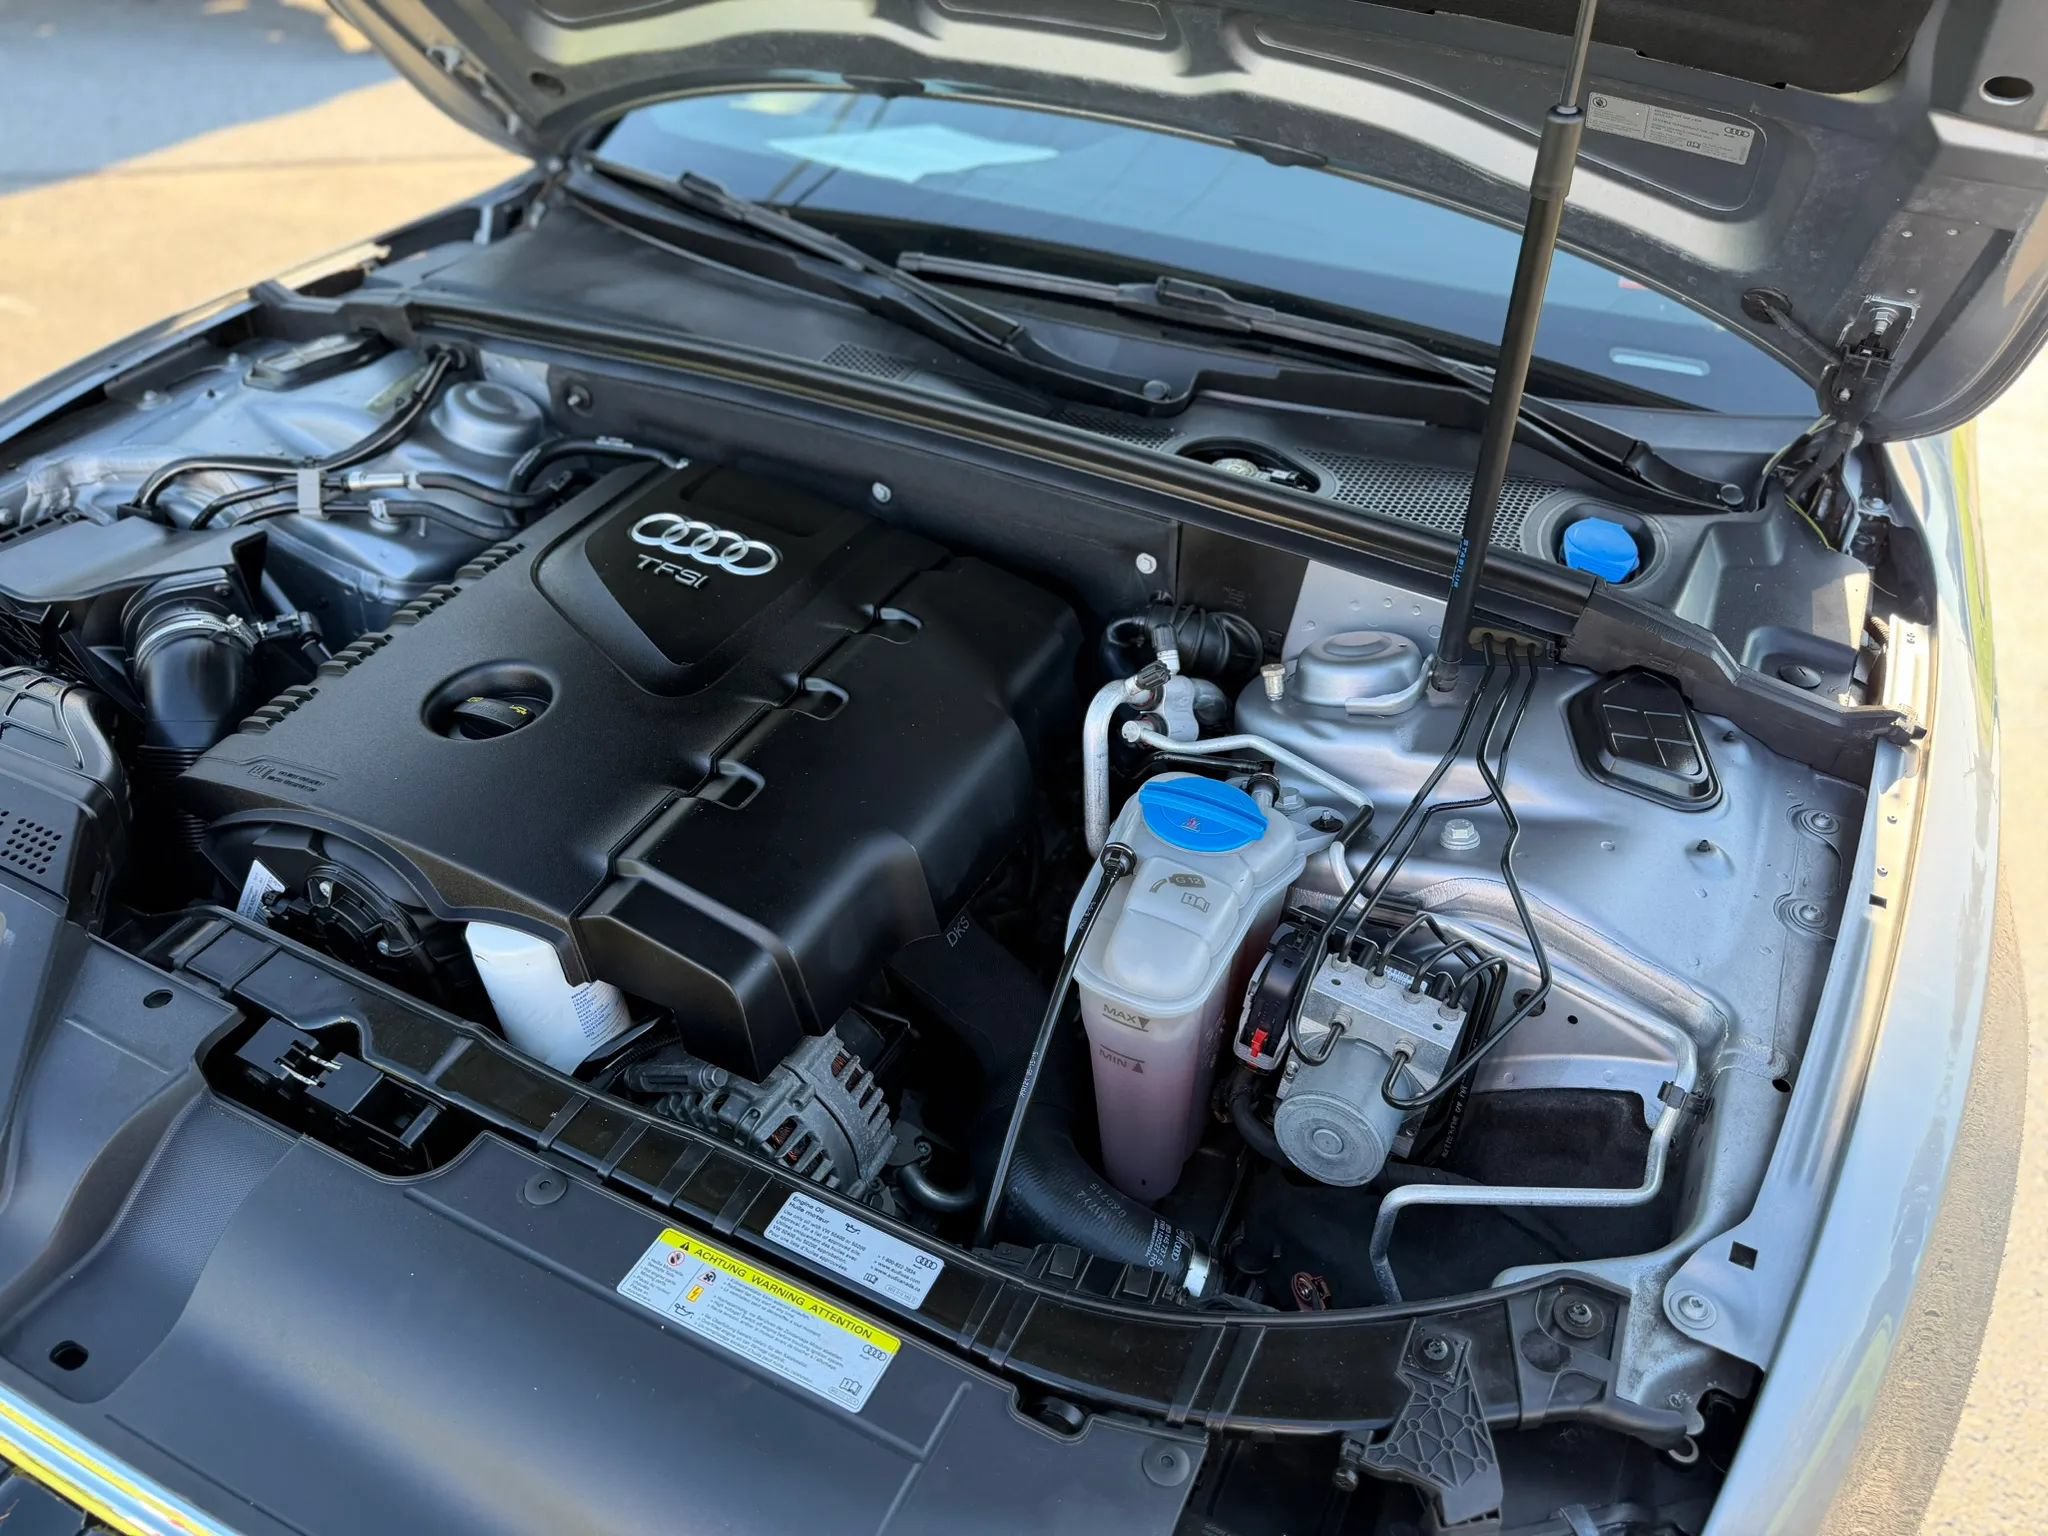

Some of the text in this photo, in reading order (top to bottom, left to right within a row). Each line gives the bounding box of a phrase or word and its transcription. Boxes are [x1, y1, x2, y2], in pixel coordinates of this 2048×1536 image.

[636, 554, 708, 589] TFSI
[946, 916, 970, 947] DKS
[1104, 1004, 1137, 1024] MAX
[1099, 1050, 1128, 1068] MIN
[788, 1201, 830, 1224] Huile moteur
[792, 1195, 824, 1214] Engine Oil
[693, 1247, 748, 1277] ACHTUNG
[748, 1274, 806, 1306] WARNING
[807, 1302, 874, 1339] ATTENTION
